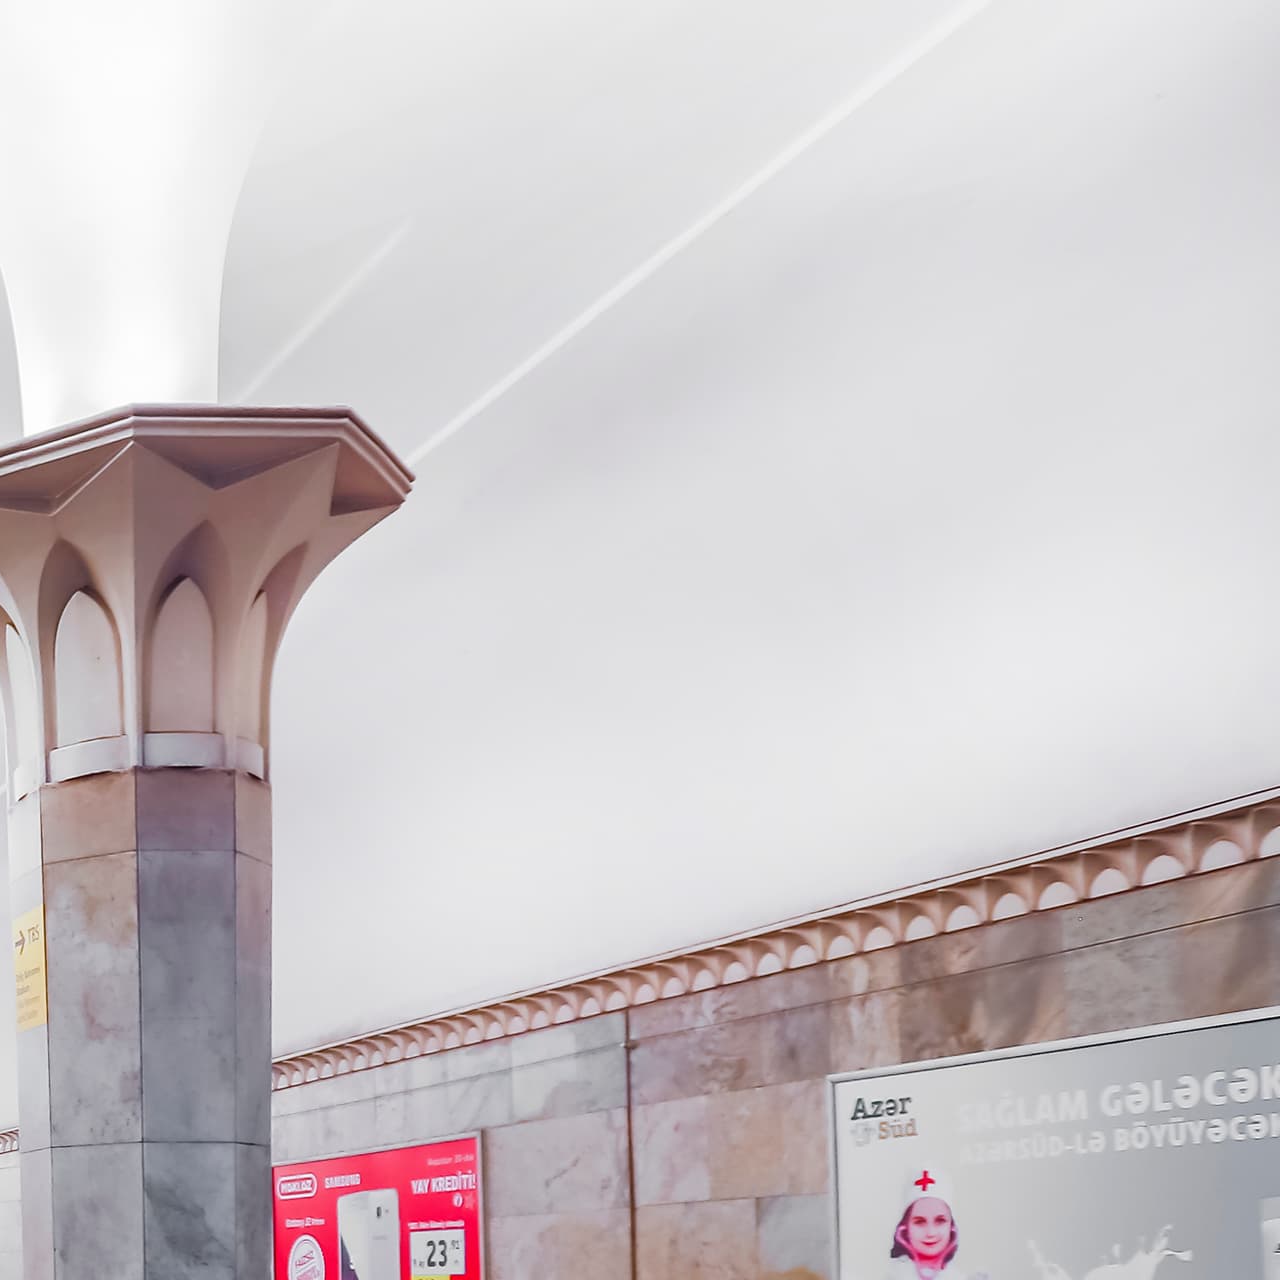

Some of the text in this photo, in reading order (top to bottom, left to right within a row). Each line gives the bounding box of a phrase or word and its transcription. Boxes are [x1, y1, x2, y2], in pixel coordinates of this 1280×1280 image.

[851, 1097, 912, 1120] Azər
[879, 1118, 918, 1140] Süd
[426, 1240, 448, 1267] 23
